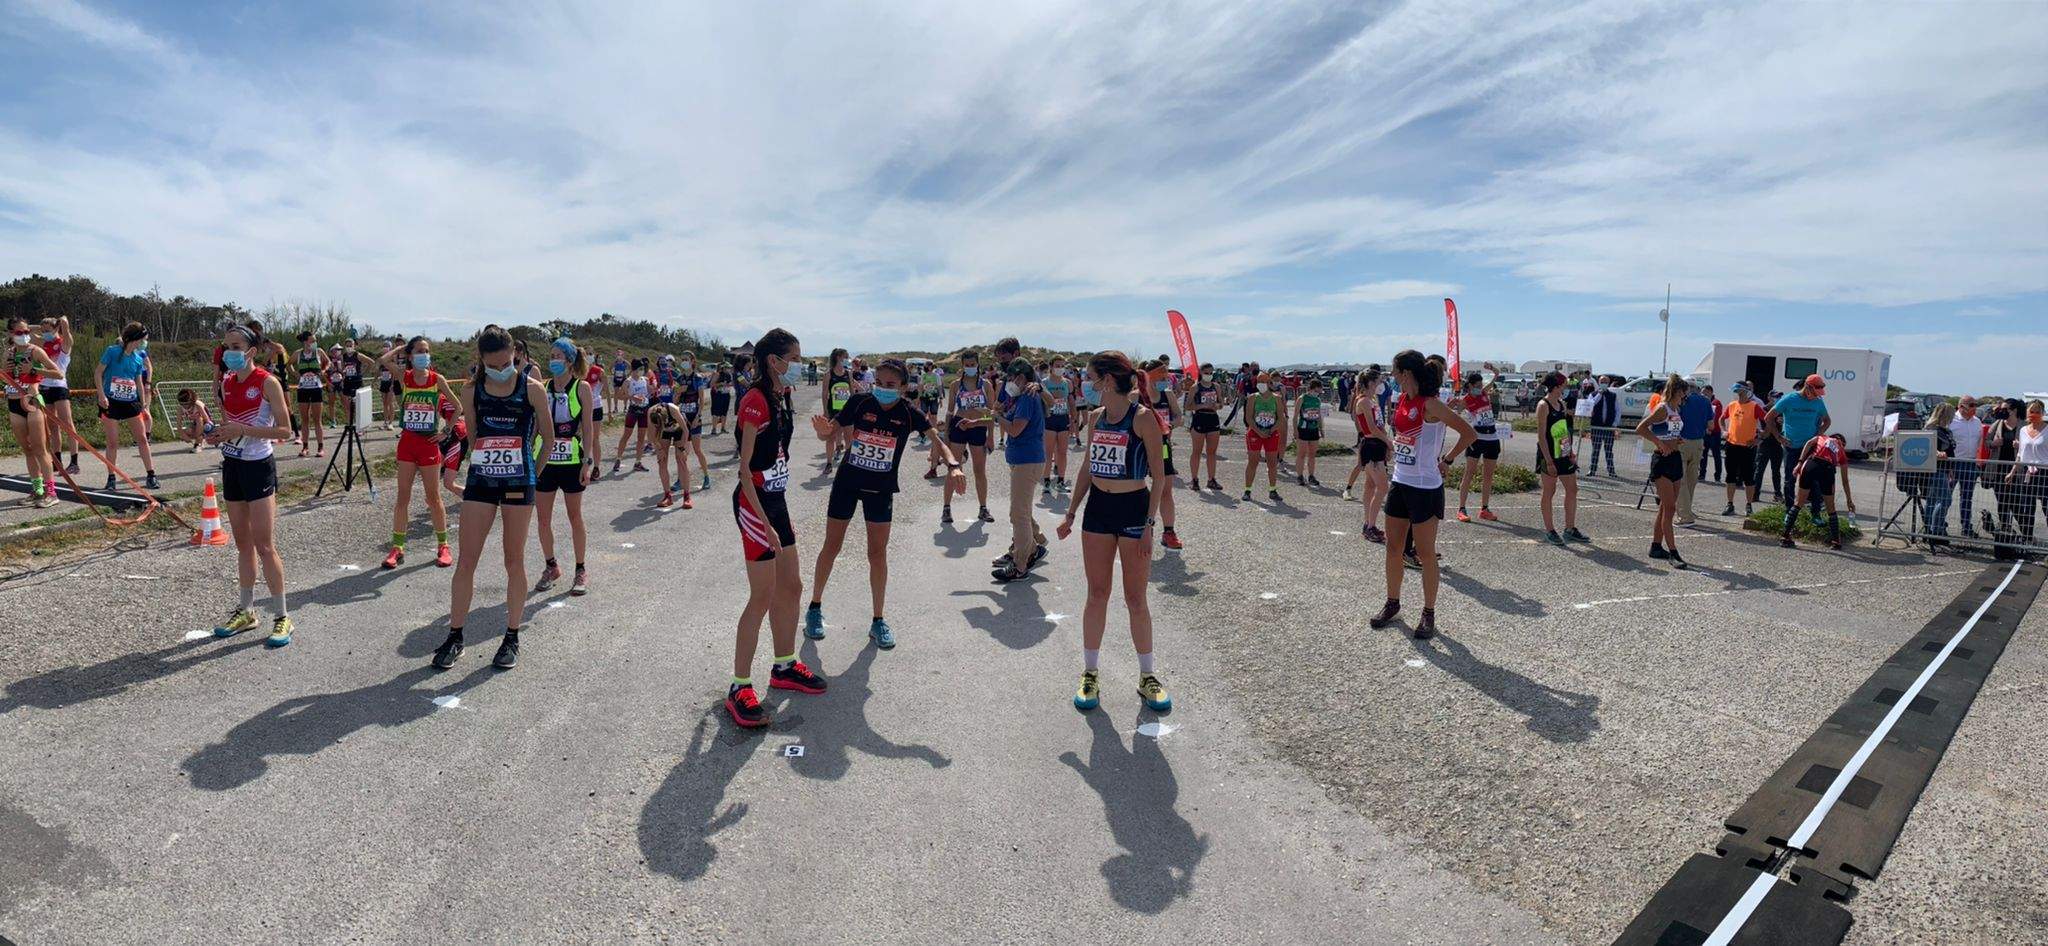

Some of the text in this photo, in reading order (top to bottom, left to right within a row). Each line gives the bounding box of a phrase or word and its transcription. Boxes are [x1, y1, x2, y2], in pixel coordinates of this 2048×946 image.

[116, 384, 133, 393] 338
[407, 411, 429, 421] 337
[482, 450, 513, 464] 326
[856, 443, 886, 460] 335
[1091, 444, 1118, 463] 324
[1091, 462, 1121, 475] oma
